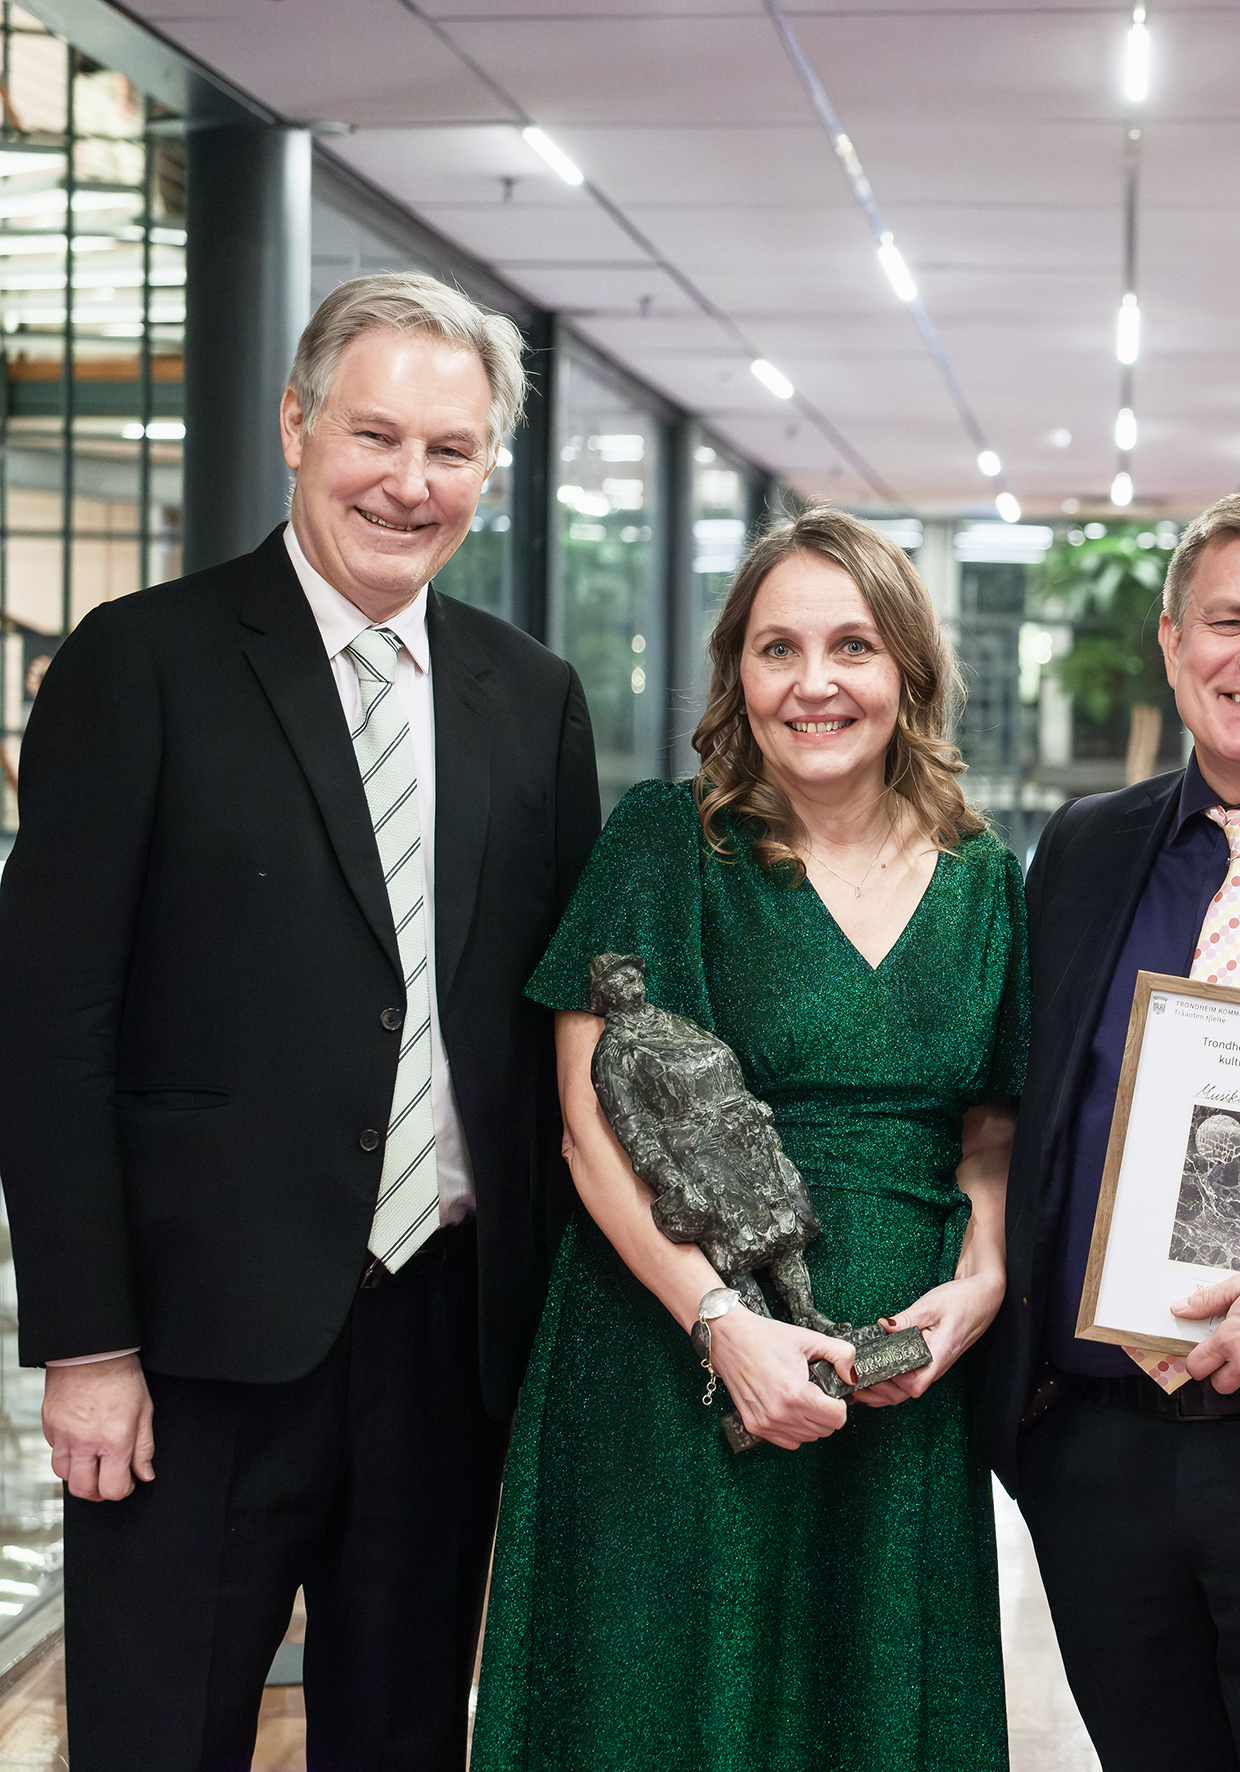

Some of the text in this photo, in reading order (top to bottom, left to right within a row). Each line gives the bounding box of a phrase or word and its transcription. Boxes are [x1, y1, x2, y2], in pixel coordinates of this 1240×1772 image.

[1176, 1000, 1217, 1012] TRONDHEIM
[1174, 1009, 1226, 1024] Tråanten tjielte
